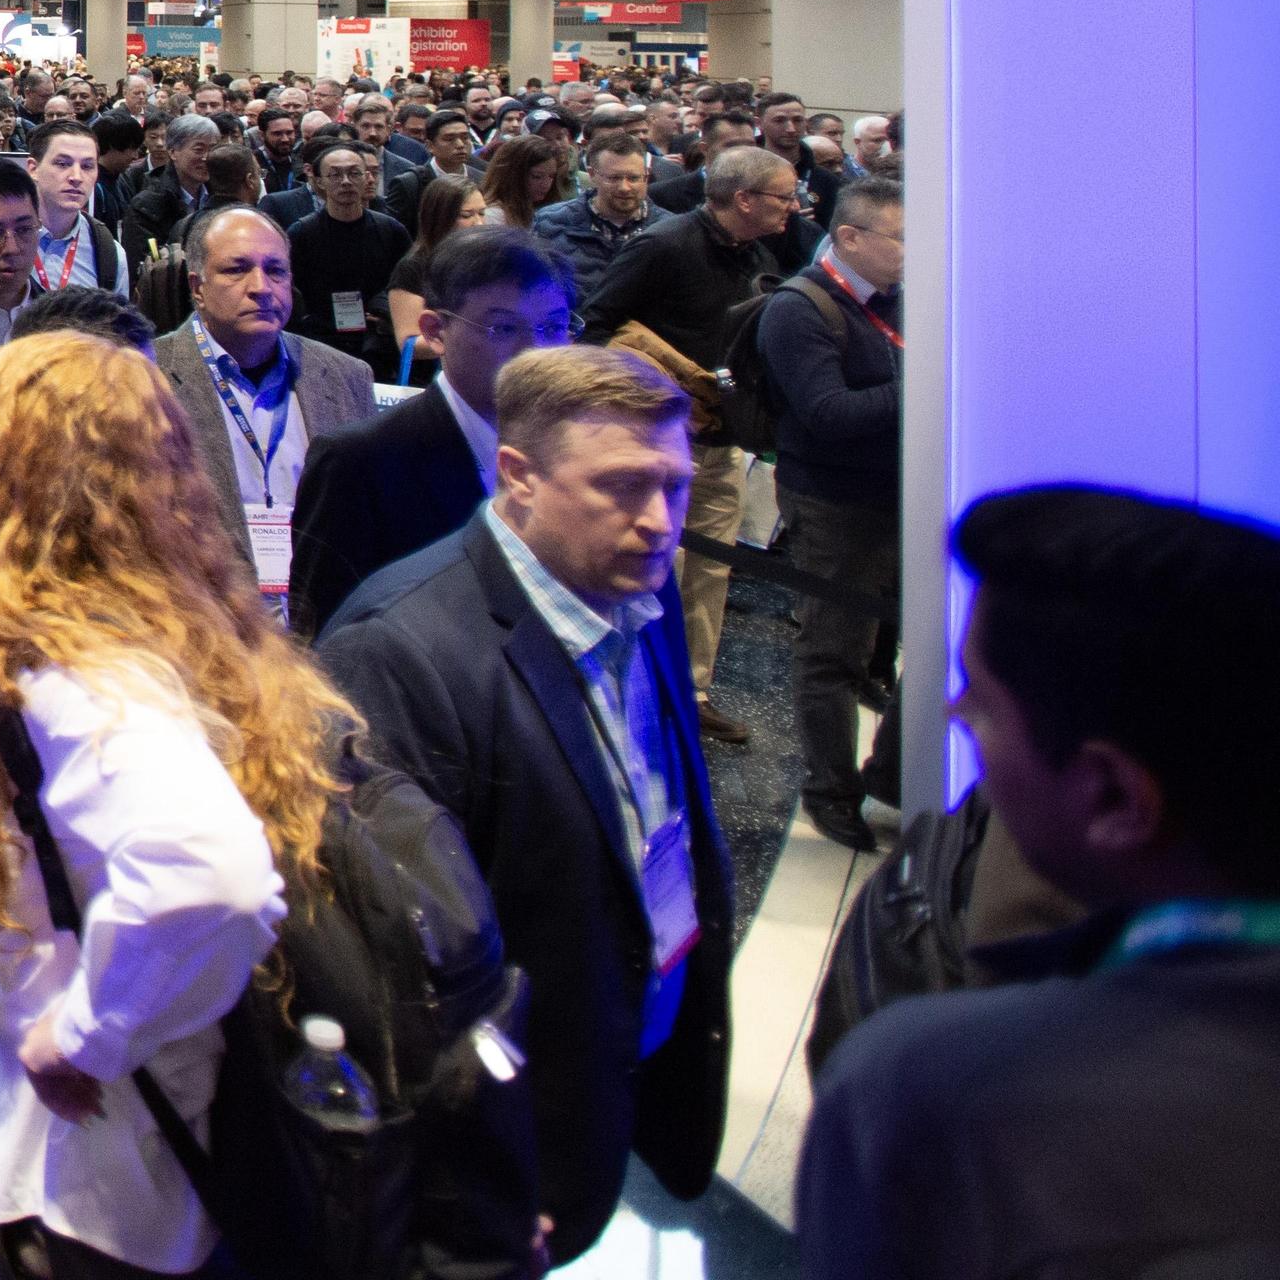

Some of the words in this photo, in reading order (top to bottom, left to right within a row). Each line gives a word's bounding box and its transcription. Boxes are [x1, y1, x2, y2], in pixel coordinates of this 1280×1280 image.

[625, 3, 668, 14] Center
[169, 31, 194, 40] Visitor
[252, 528, 289, 536] RONALDO
